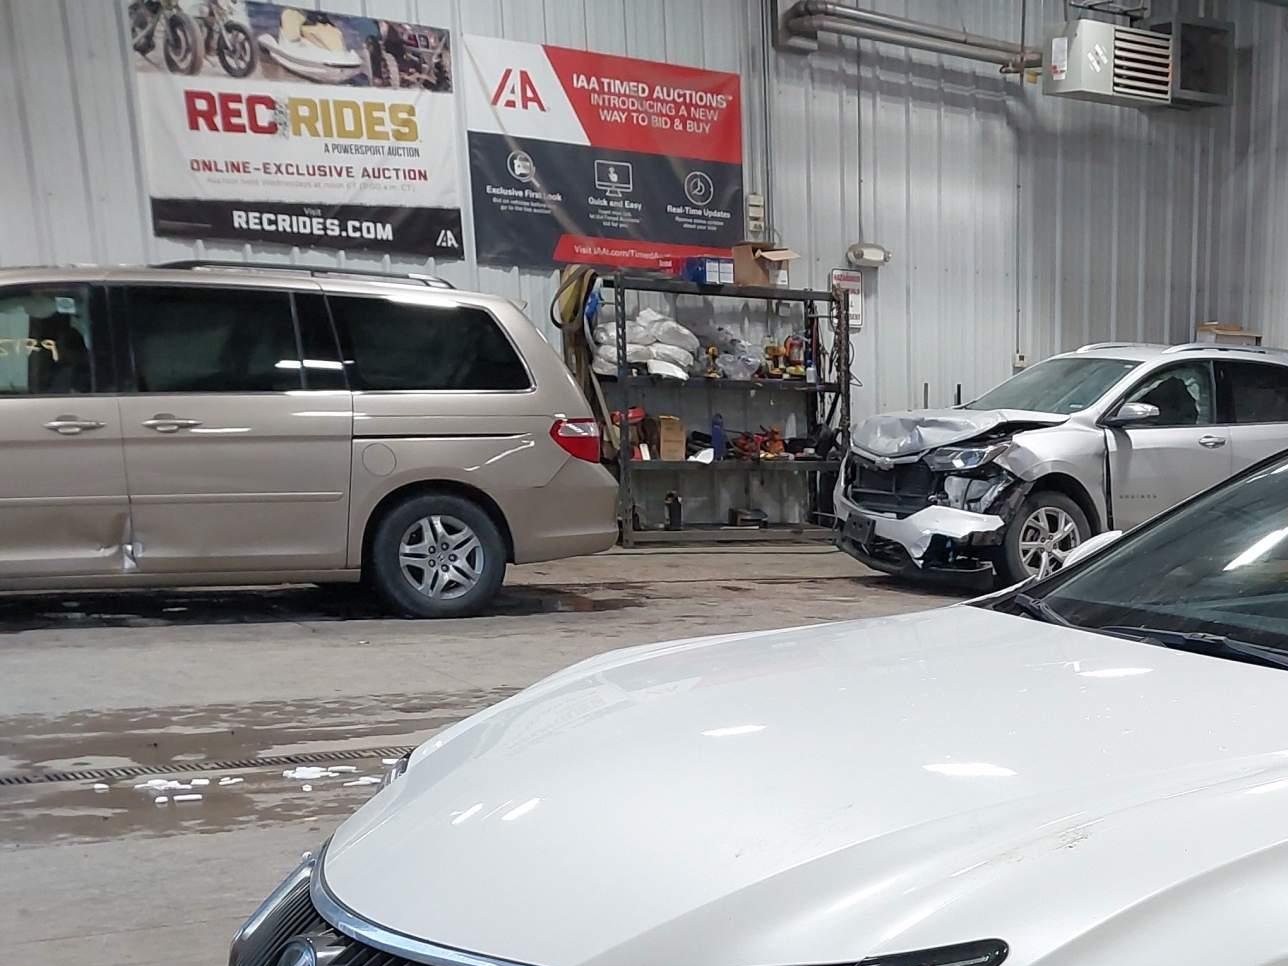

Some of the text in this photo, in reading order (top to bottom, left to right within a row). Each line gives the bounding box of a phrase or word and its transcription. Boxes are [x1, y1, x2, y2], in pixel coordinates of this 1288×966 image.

[572, 73, 599, 91] IAA
[601, 78, 649, 97] TIMED
[184, 89, 419, 142] REC RIDES
[590, 93, 719, 121] INTRODUCING A NEW
[599, 110, 711, 134] WAY TO BID & BUY
[323, 143, 420, 158] A POWERSPORT AUCTION
[190, 158, 428, 181] ONLINE-EXCLUSIVE AUCTION
[486, 185, 523, 197] Exclusive
[588, 196, 608, 207] Quick
[624, 200, 642, 211] Easy
[666, 204, 731, 219] Real-Time Updates
[232, 210, 393, 241] RECRIDES.COM
